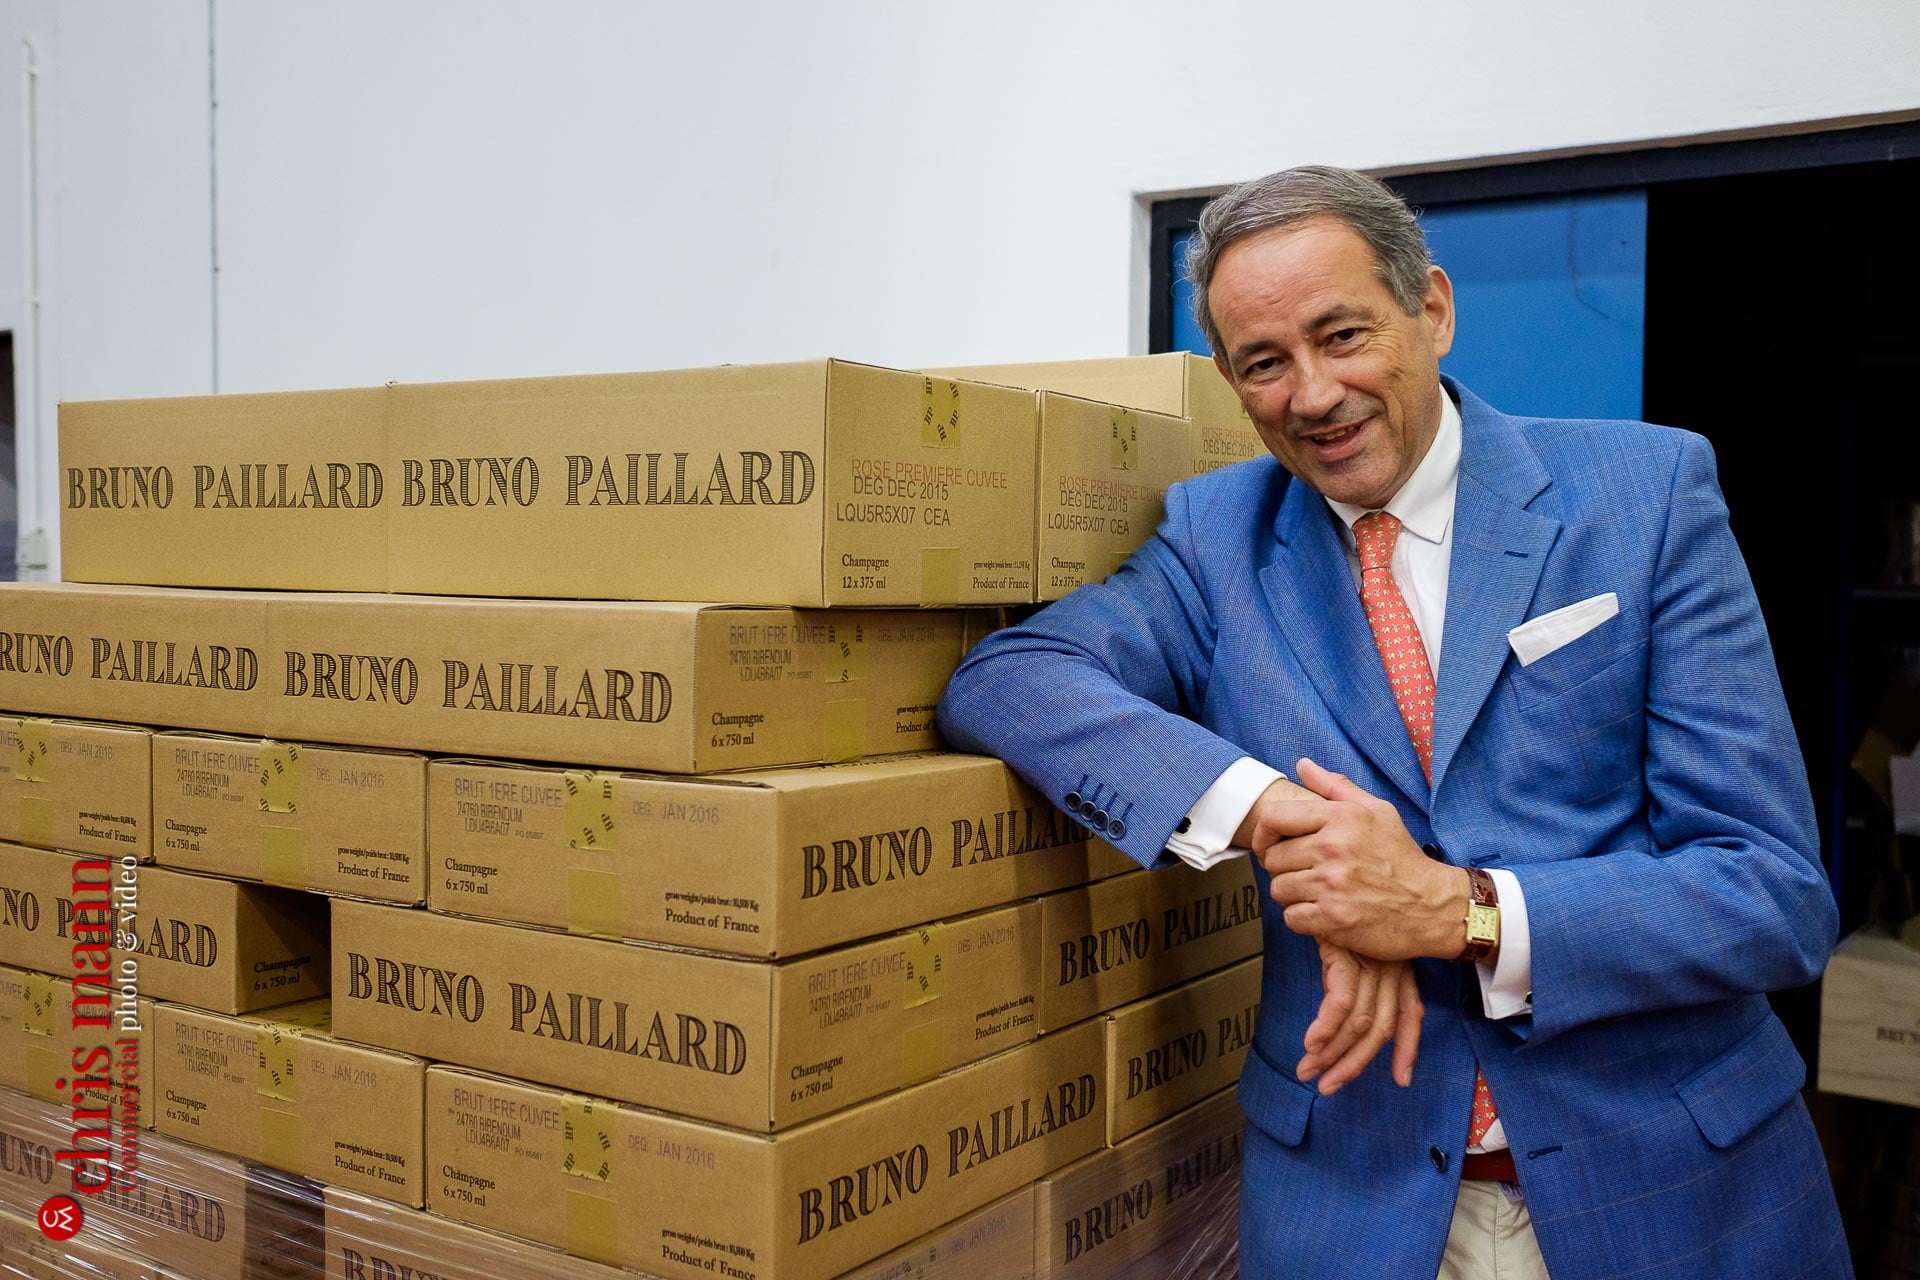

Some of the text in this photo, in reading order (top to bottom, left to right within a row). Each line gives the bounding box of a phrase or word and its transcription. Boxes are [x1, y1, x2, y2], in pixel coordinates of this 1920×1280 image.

[1203, 440, 1254, 458] DEG DEC 2015
[67, 462, 384, 509] BRUNO PAILLARD
[401, 450, 815, 507] BRUNO PAILLARD
[851, 459, 1007, 489] ROSE PREMIERE CUVEE
[853, 475, 949, 500] DEG DEC 2015
[1060, 476, 1088, 493] ROSE
[1091, 480, 1138, 500] PREMIERE
[1061, 491, 1128, 513] DEG DEC 2015
[836, 503, 950, 527] LQU5R5X07 CEA
[1048, 513, 1130, 535] LQU5R5X07 CEA
[842, 554, 889, 571] Champagne
[1051, 557, 1086, 572] Champagne
[842, 576, 886, 588] 12 375 ml
[972, 577, 1029, 589] Product France
[730, 625, 758, 644] BRUT
[762, 625, 787, 644] 1ERE
[0, 631, 258, 691] RUNO PAILLARD
[283, 651, 672, 723] BRUNO PAILLARD
[711, 711, 764, 728] Champagne
[896, 721, 921, 733] Product
[725, 732, 754, 746] 750 ml
[175, 749, 260, 774] BRUT 1ERE CUVEE
[337, 770, 384, 788] JAN 2016
[455, 778, 562, 807] BRUT 1ERE CUVEE
[481, 803, 522, 822] BIBENDUM
[661, 803, 719, 825] JAN 2016
[79, 824, 137, 843] Product France
[165, 819, 207, 836] Champagne
[177, 838, 199, 851] 750 ml
[338, 862, 409, 883] Product of France
[445, 858, 498, 878] Champagne
[801, 826, 933, 900] BRUNO
[459, 879, 489, 895] 750 ml
[665, 908, 760, 934] Product of France
[1059, 885, 1262, 987] BRUNO PAILLAR
[270, 976, 286, 988] 750
[808, 952, 905, 994] BRUT 1ERE CUVEE
[347, 952, 747, 1075] BRUNO PAILLARD
[975, 1013, 1034, 1040] Product of France
[175, 1022, 258, 1058] BRUT 1ERE CUVEE
[791, 1056, 843, 1080] Champagne
[1127, 1026, 1206, 1100] BRUNO
[332, 1063, 377, 1089] JAN 2016
[805, 1077, 833, 1098] 750 ml
[85, 1087, 109, 1102] Product
[166, 1090, 207, 1111] Champagne
[177, 1110, 199, 1125] 750 ml
[454, 1088, 560, 1131] BRUT 1ERE CUVEE
[456, 1111, 521, 1141] 24760 BIBENDUM
[0, 1133, 53, 1184] UNO
[629, 1135, 715, 1169] DEG JAN 2016
[797, 1073, 1097, 1246] BRUNO PAILLARD
[334, 1155, 365, 1174] Product
[366, 1165, 377, 1177] of
[378, 1168, 406, 1185] France
[442, 1165, 496, 1190] Champagne
[457, 1189, 486, 1207] 750 ml
[1064, 1179, 1152, 1265] BRUNO
[1165, 1130, 1240, 1205] PAILLA
[661, 1245, 702, 1269] Product
[704, 1257, 717, 1272] of
[719, 1260, 756, 1280] France
